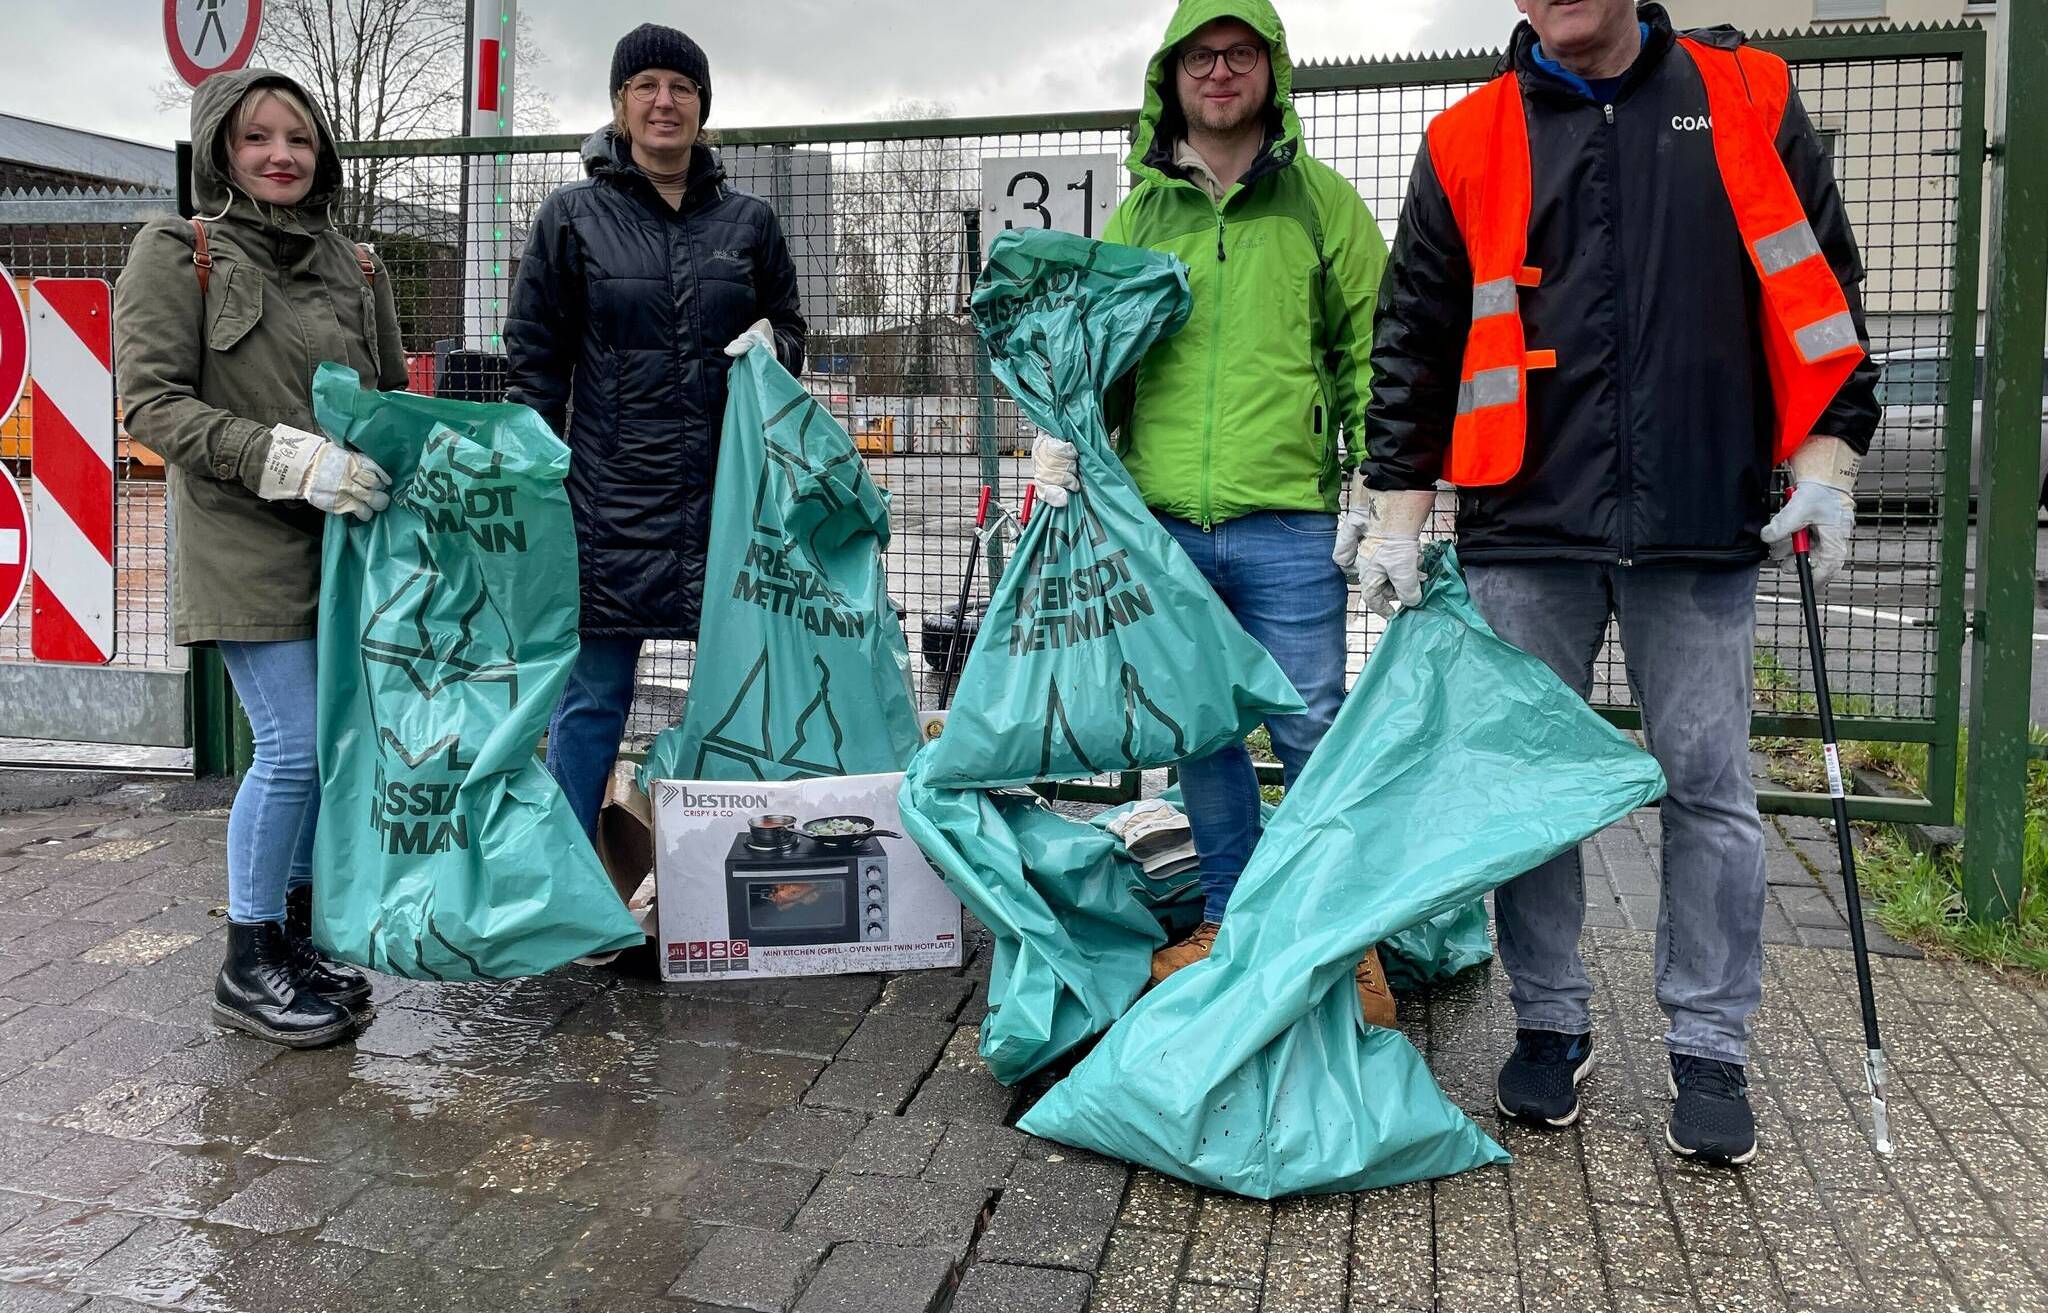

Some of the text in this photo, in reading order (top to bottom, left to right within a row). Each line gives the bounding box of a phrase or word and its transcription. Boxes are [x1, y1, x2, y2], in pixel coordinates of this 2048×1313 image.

[1004, 169, 1094, 239] 31
[762, 949, 781, 957] MINI
[783, 948, 816, 957] KITCHEN
[817, 946, 842, 956] (GRILL
[849, 945, 872, 953] OVEN
[873, 944, 892, 952] WITH
[894, 943, 913, 951] TWIN
[915, 941, 955, 950] HOTPLATE)
